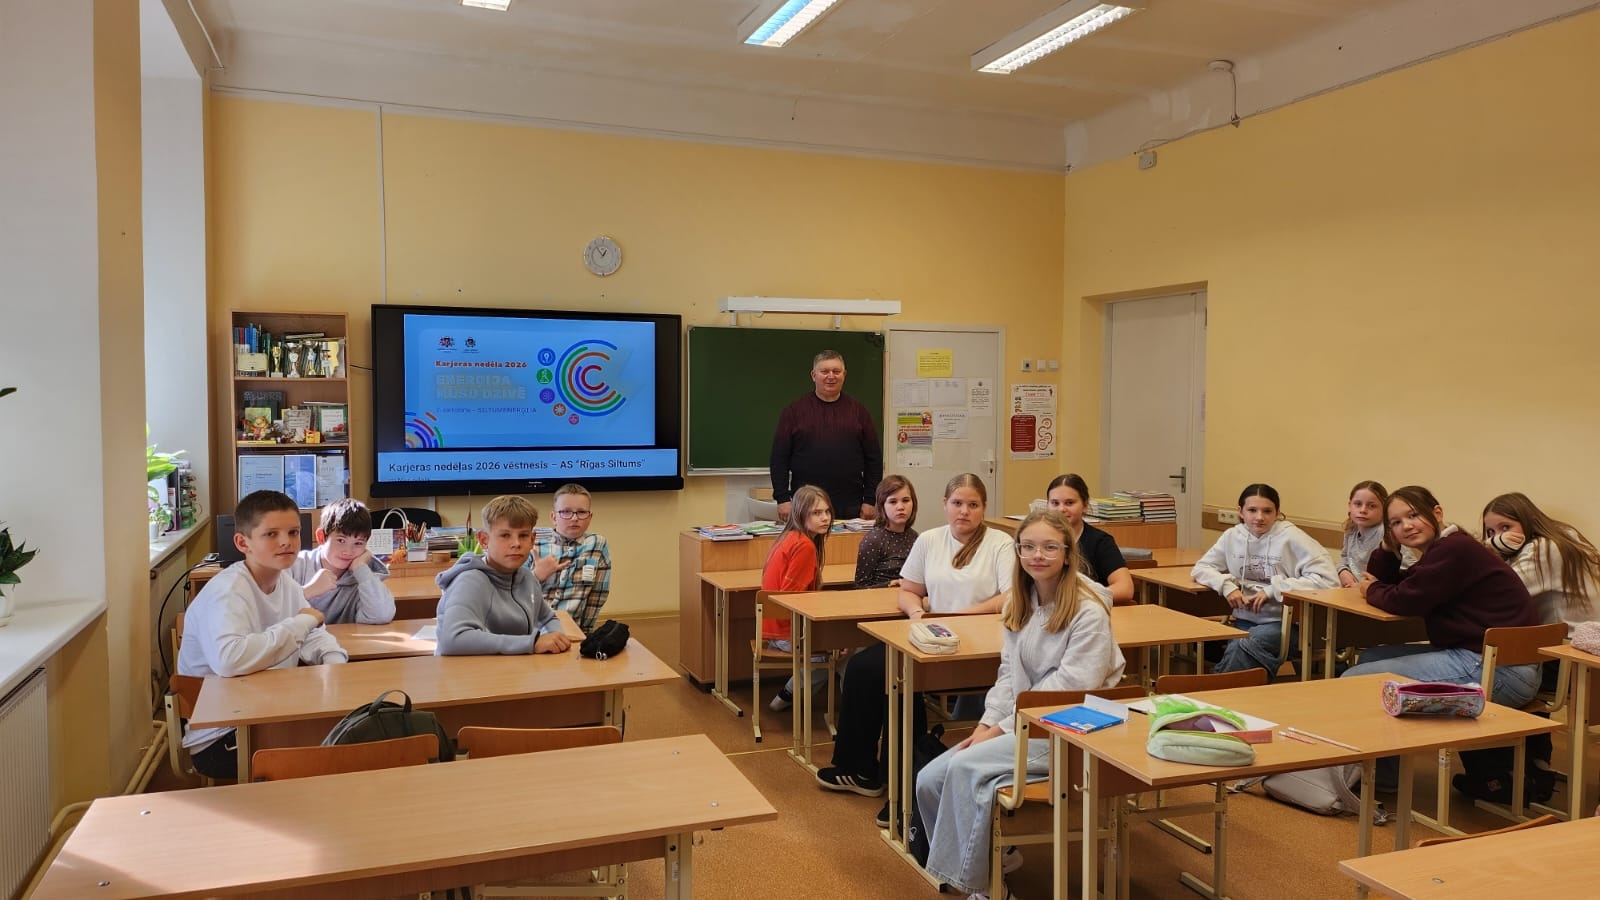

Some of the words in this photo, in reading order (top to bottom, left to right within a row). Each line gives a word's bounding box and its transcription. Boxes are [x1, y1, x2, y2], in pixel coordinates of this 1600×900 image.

[389, 463, 431, 473] Karjeras
[434, 461, 473, 472] nedēļas
[476, 461, 500, 471] 2026
[503, 460, 548, 470] vēstnesis
[560, 460, 573, 469] AS
